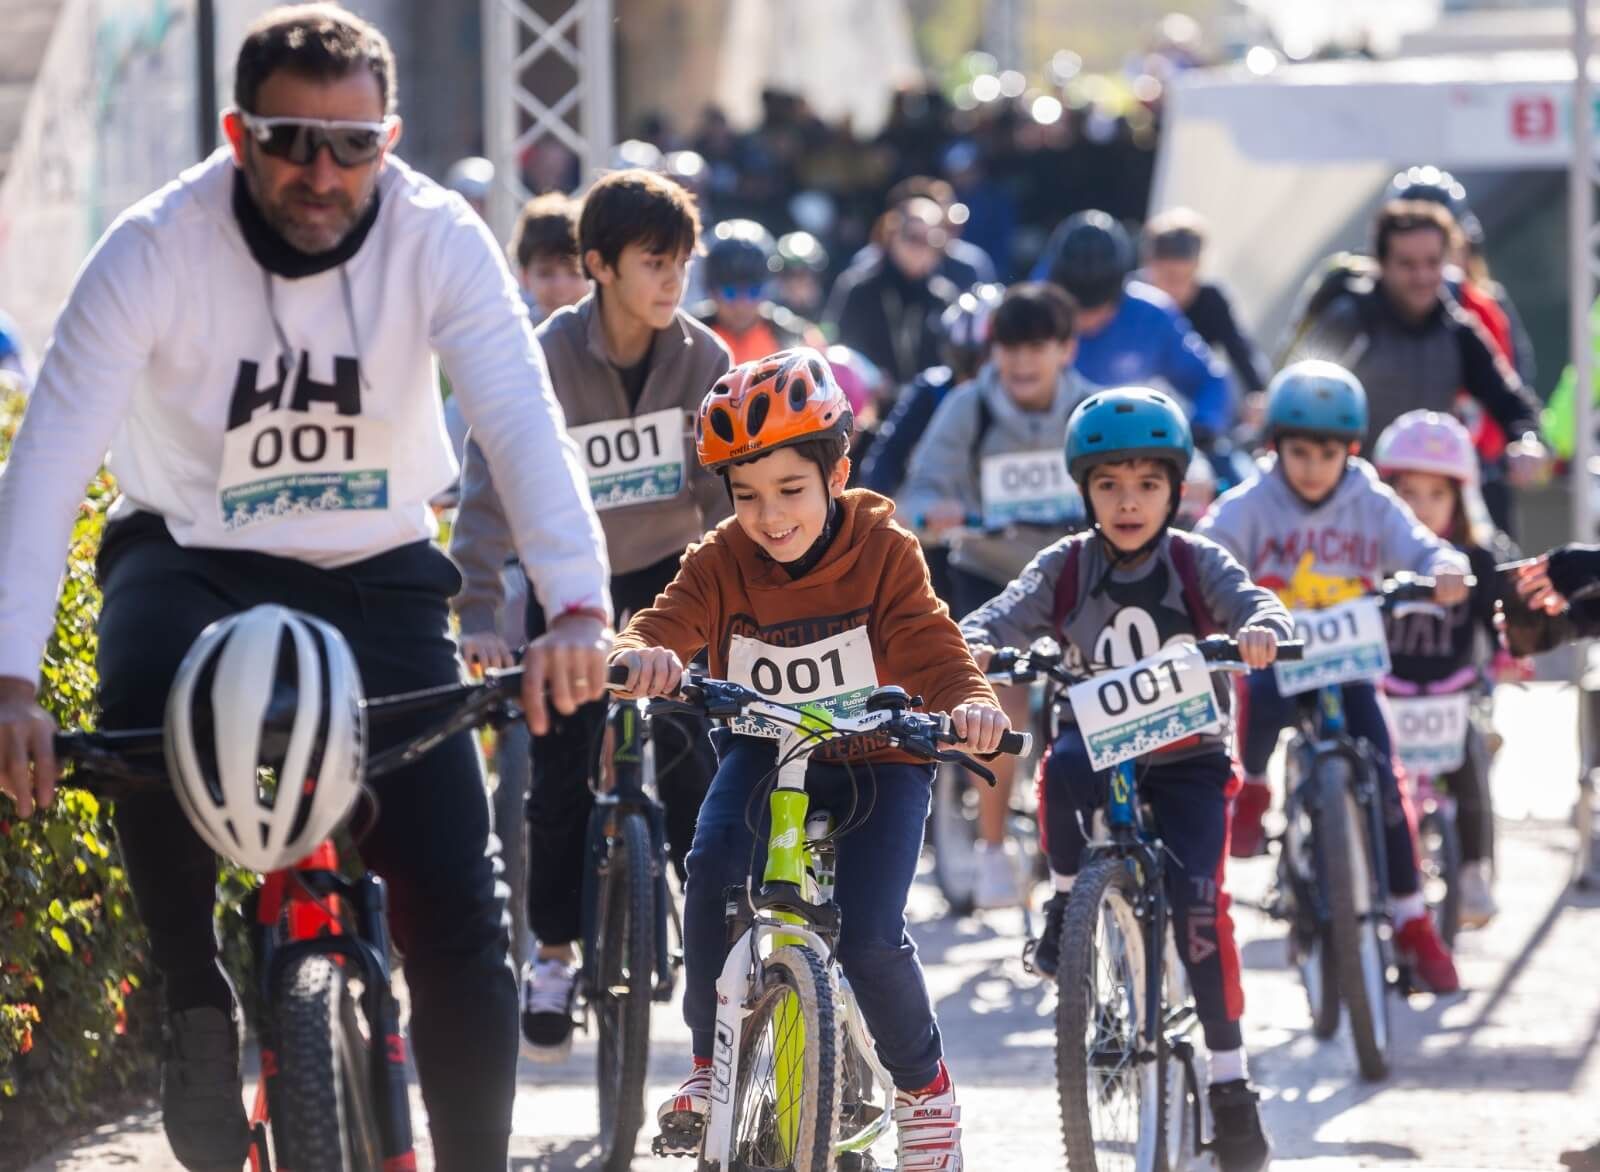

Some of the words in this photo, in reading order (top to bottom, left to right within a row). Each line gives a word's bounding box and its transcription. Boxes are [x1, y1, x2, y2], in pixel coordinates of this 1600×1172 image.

[251, 424, 355, 468] 001
[586, 424, 660, 468] 001
[1002, 460, 1060, 492] 001
[751, 648, 845, 696] 001
[1098, 659, 1183, 717] 001
[1398, 709, 1458, 740] 001
[1188, 877, 1216, 964] FILA
